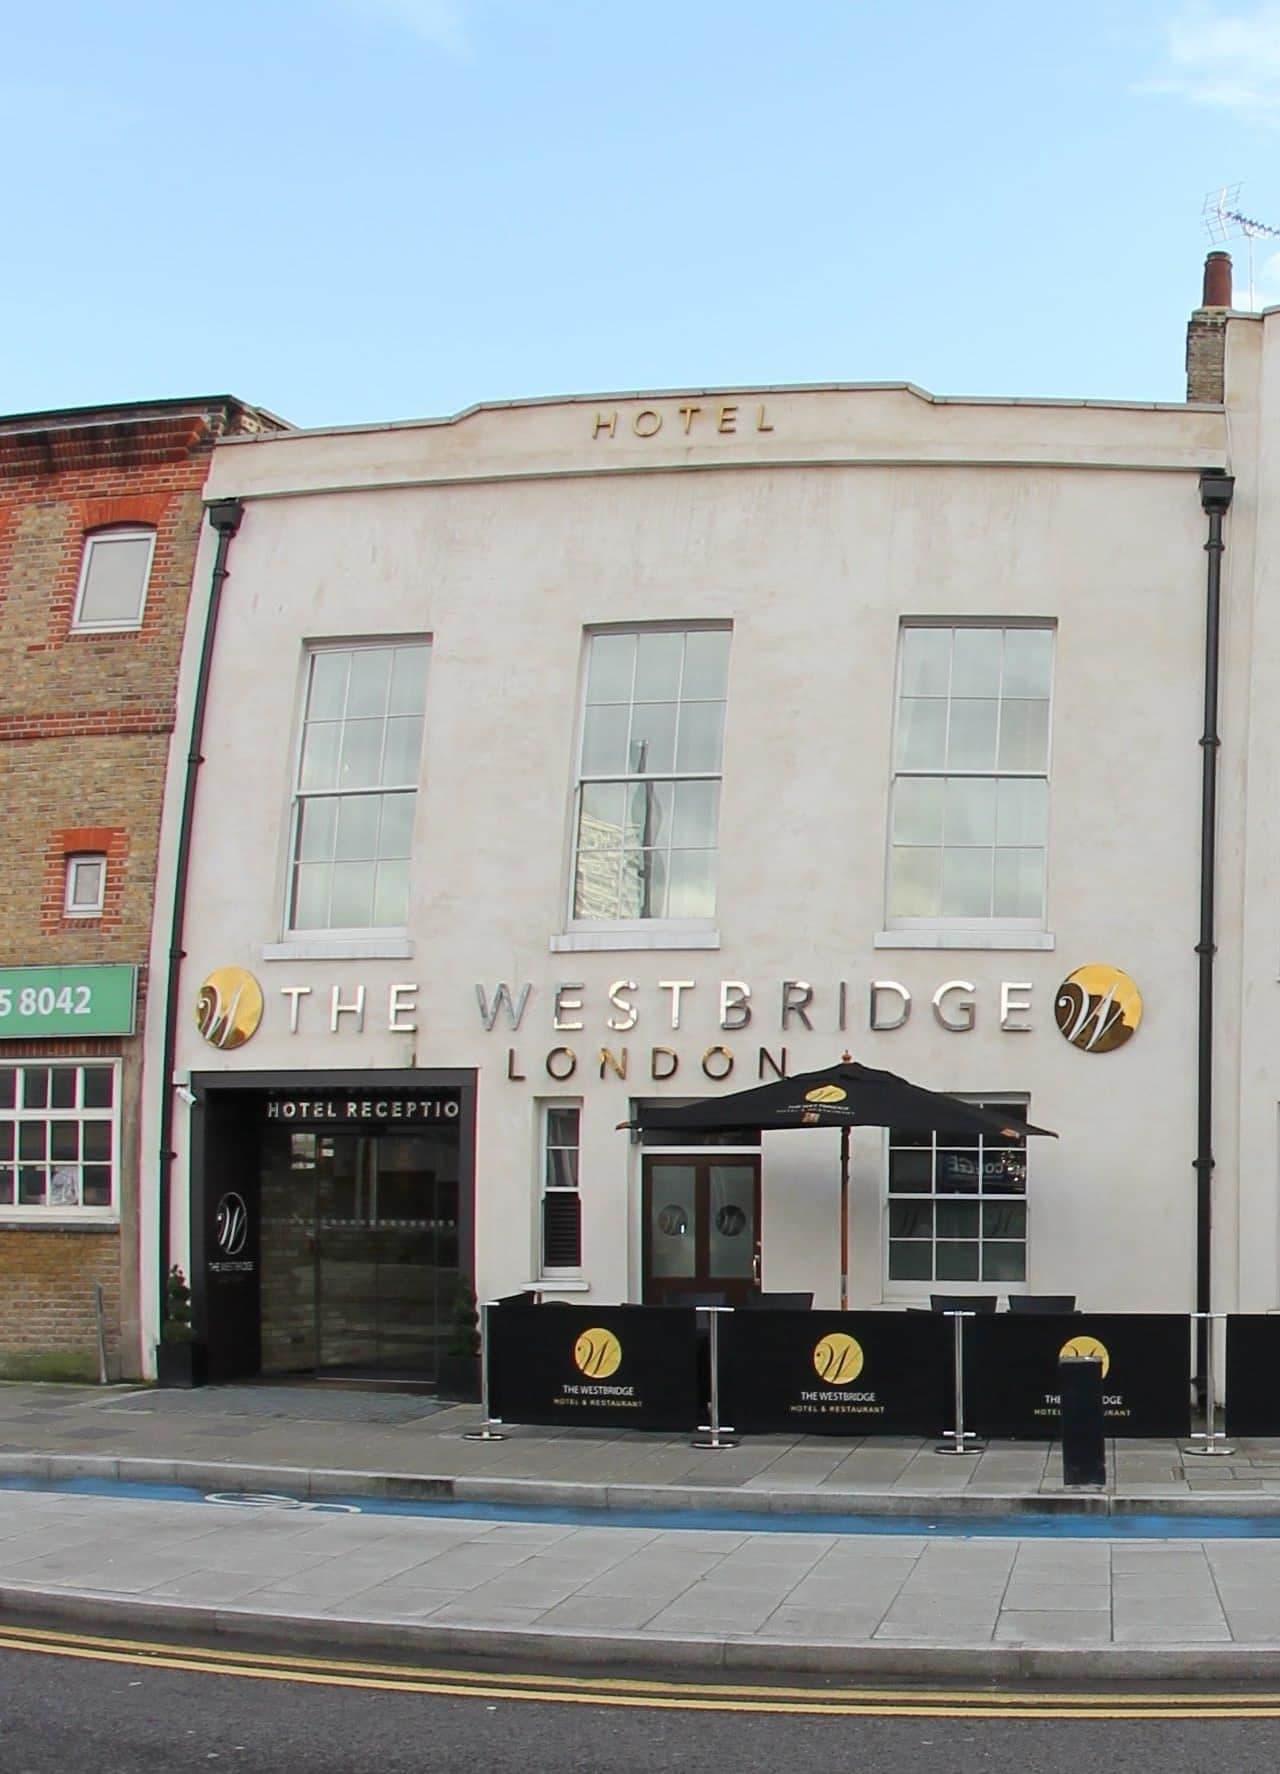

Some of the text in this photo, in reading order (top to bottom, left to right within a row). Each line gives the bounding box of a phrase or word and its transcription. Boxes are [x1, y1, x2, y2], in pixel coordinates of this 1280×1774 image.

[592, 404, 775, 439] HOTEL
[19, 985, 91, 1016] 8042
[281, 979, 1034, 1034] THE WESTBRIDGE
[508, 1046, 790, 1081] LONDON
[267, 1101, 460, 1118] HOTEL RECEPTIO
[562, 1384, 635, 1396] THE WESTBRIDGE
[801, 1391, 876, 1402] THE WESTBRIDGE
